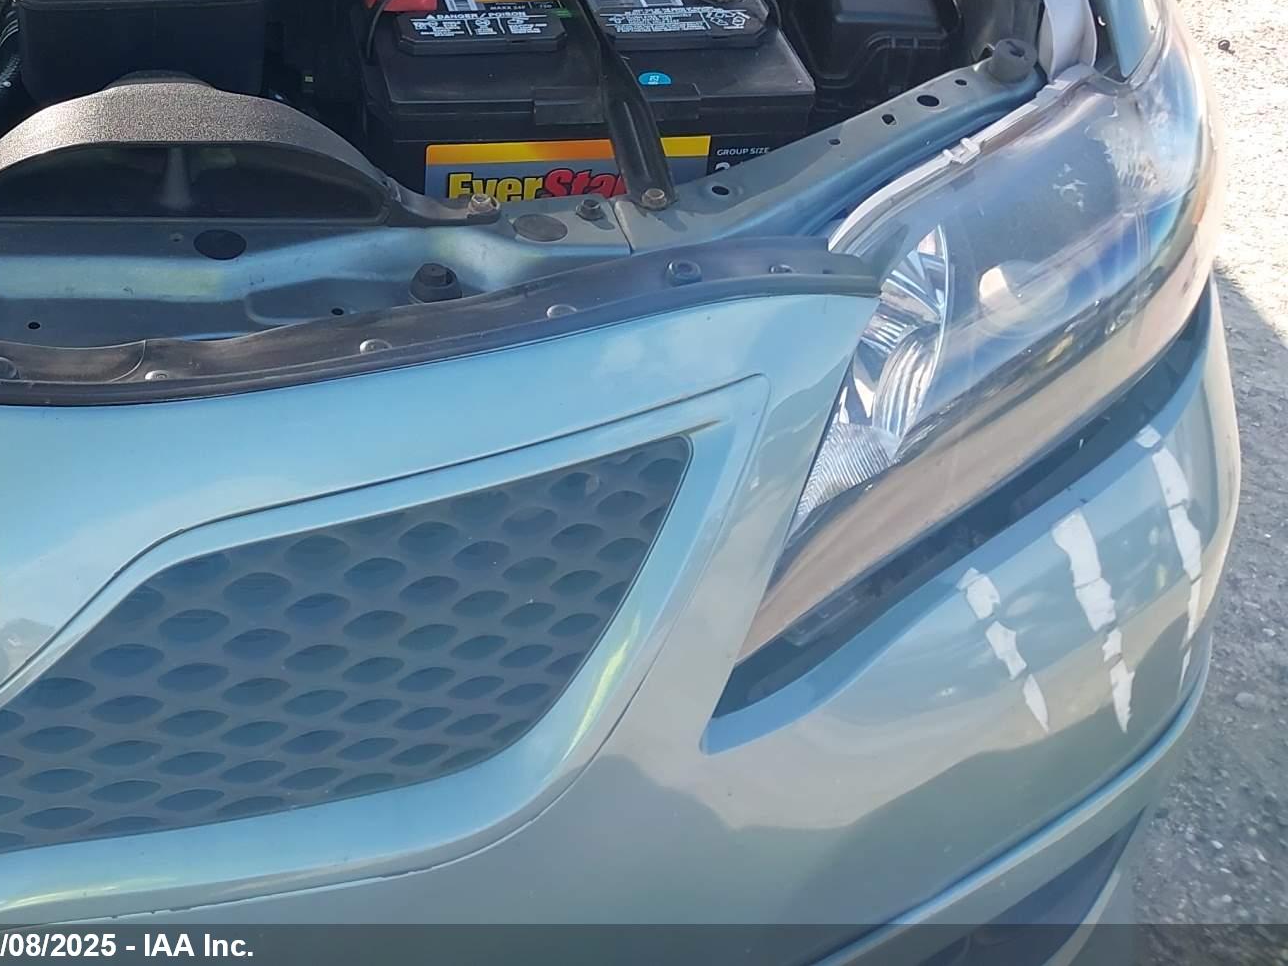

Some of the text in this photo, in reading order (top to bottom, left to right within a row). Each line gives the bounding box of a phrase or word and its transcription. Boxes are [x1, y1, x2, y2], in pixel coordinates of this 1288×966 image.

[716, 147, 769, 156] GROUP SIZE
[448, 168, 627, 202] EverSta
